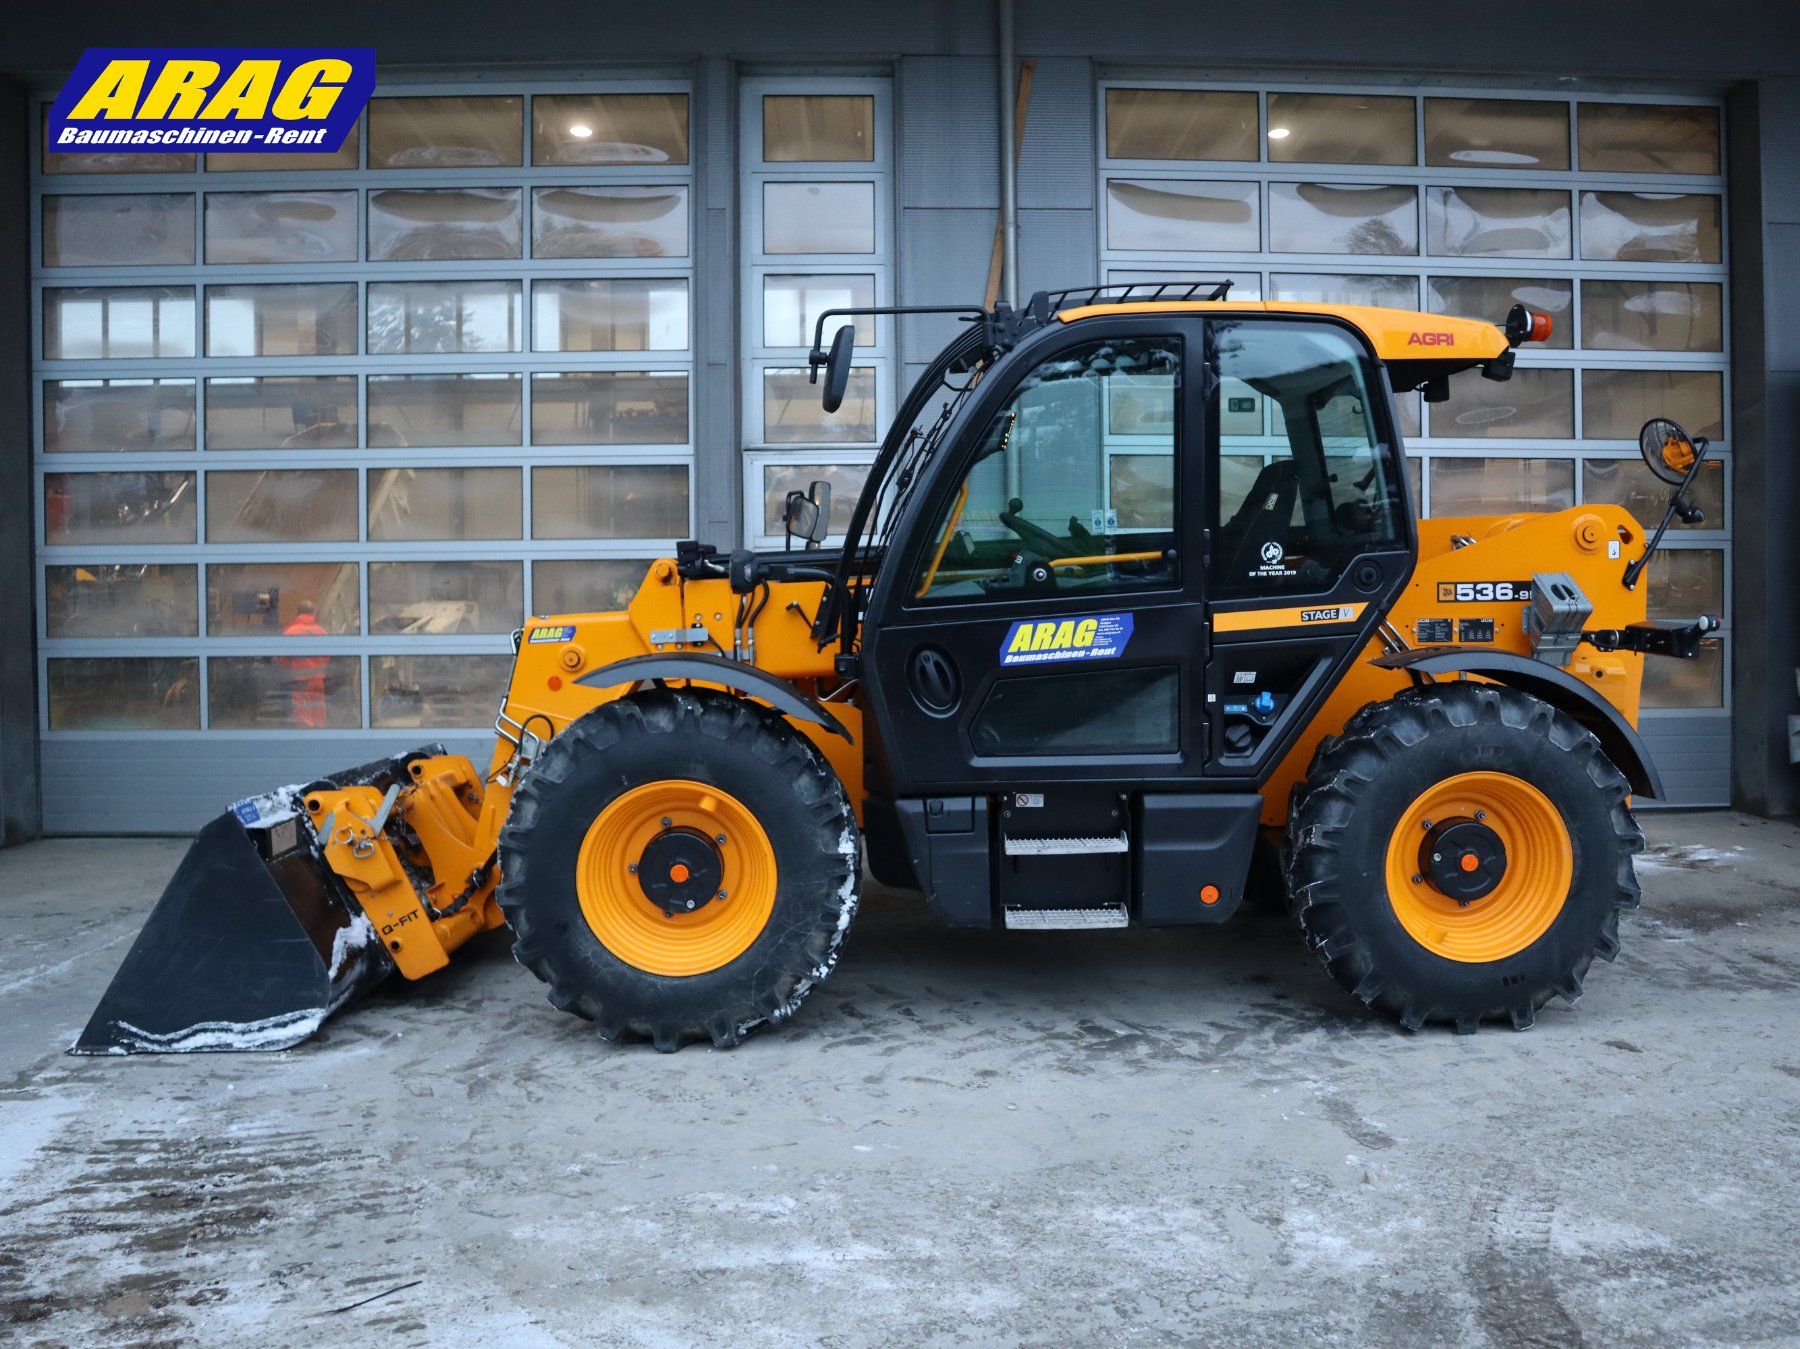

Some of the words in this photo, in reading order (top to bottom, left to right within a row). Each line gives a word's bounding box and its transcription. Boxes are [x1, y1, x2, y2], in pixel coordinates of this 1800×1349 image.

[1407, 332, 1455, 346] AGRI
[1302, 610, 1337, 621] STAGE
[531, 627, 564, 639] ARAG
[1008, 619, 1098, 653] ARAG
[1004, 647, 1116, 663] Baumaschinen-Rent
[382, 908, 418, 936] Q-FIT
